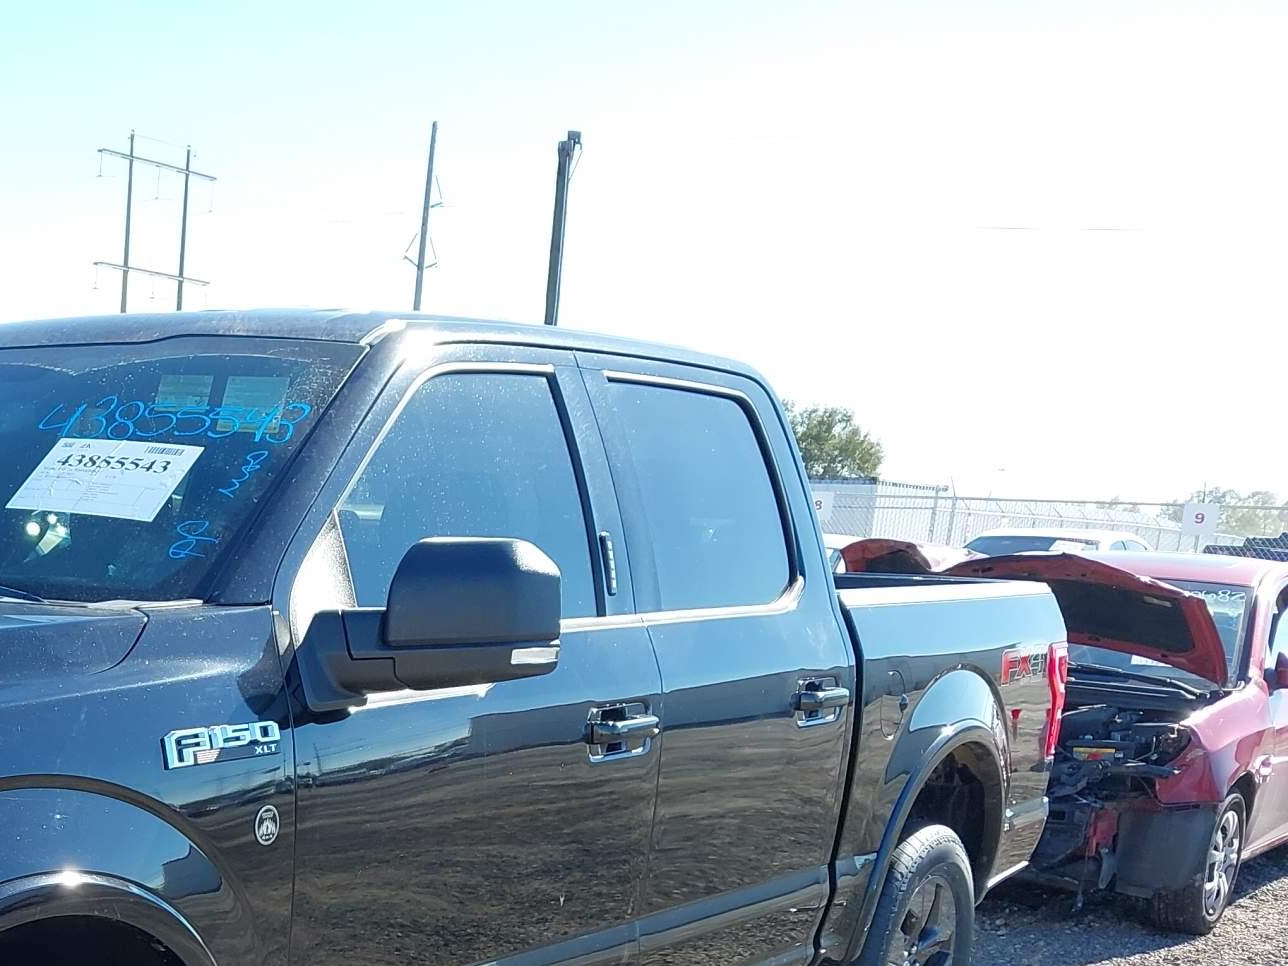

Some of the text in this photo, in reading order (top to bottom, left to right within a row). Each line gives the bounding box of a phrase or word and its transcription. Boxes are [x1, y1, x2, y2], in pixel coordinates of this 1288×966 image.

[39, 395, 310, 444] 43855543
[56, 453, 172, 475] 43855543
[1194, 513, 1205, 524] 9
[1001, 648, 1048, 687] FX4
[255, 744, 277, 755] XLT
